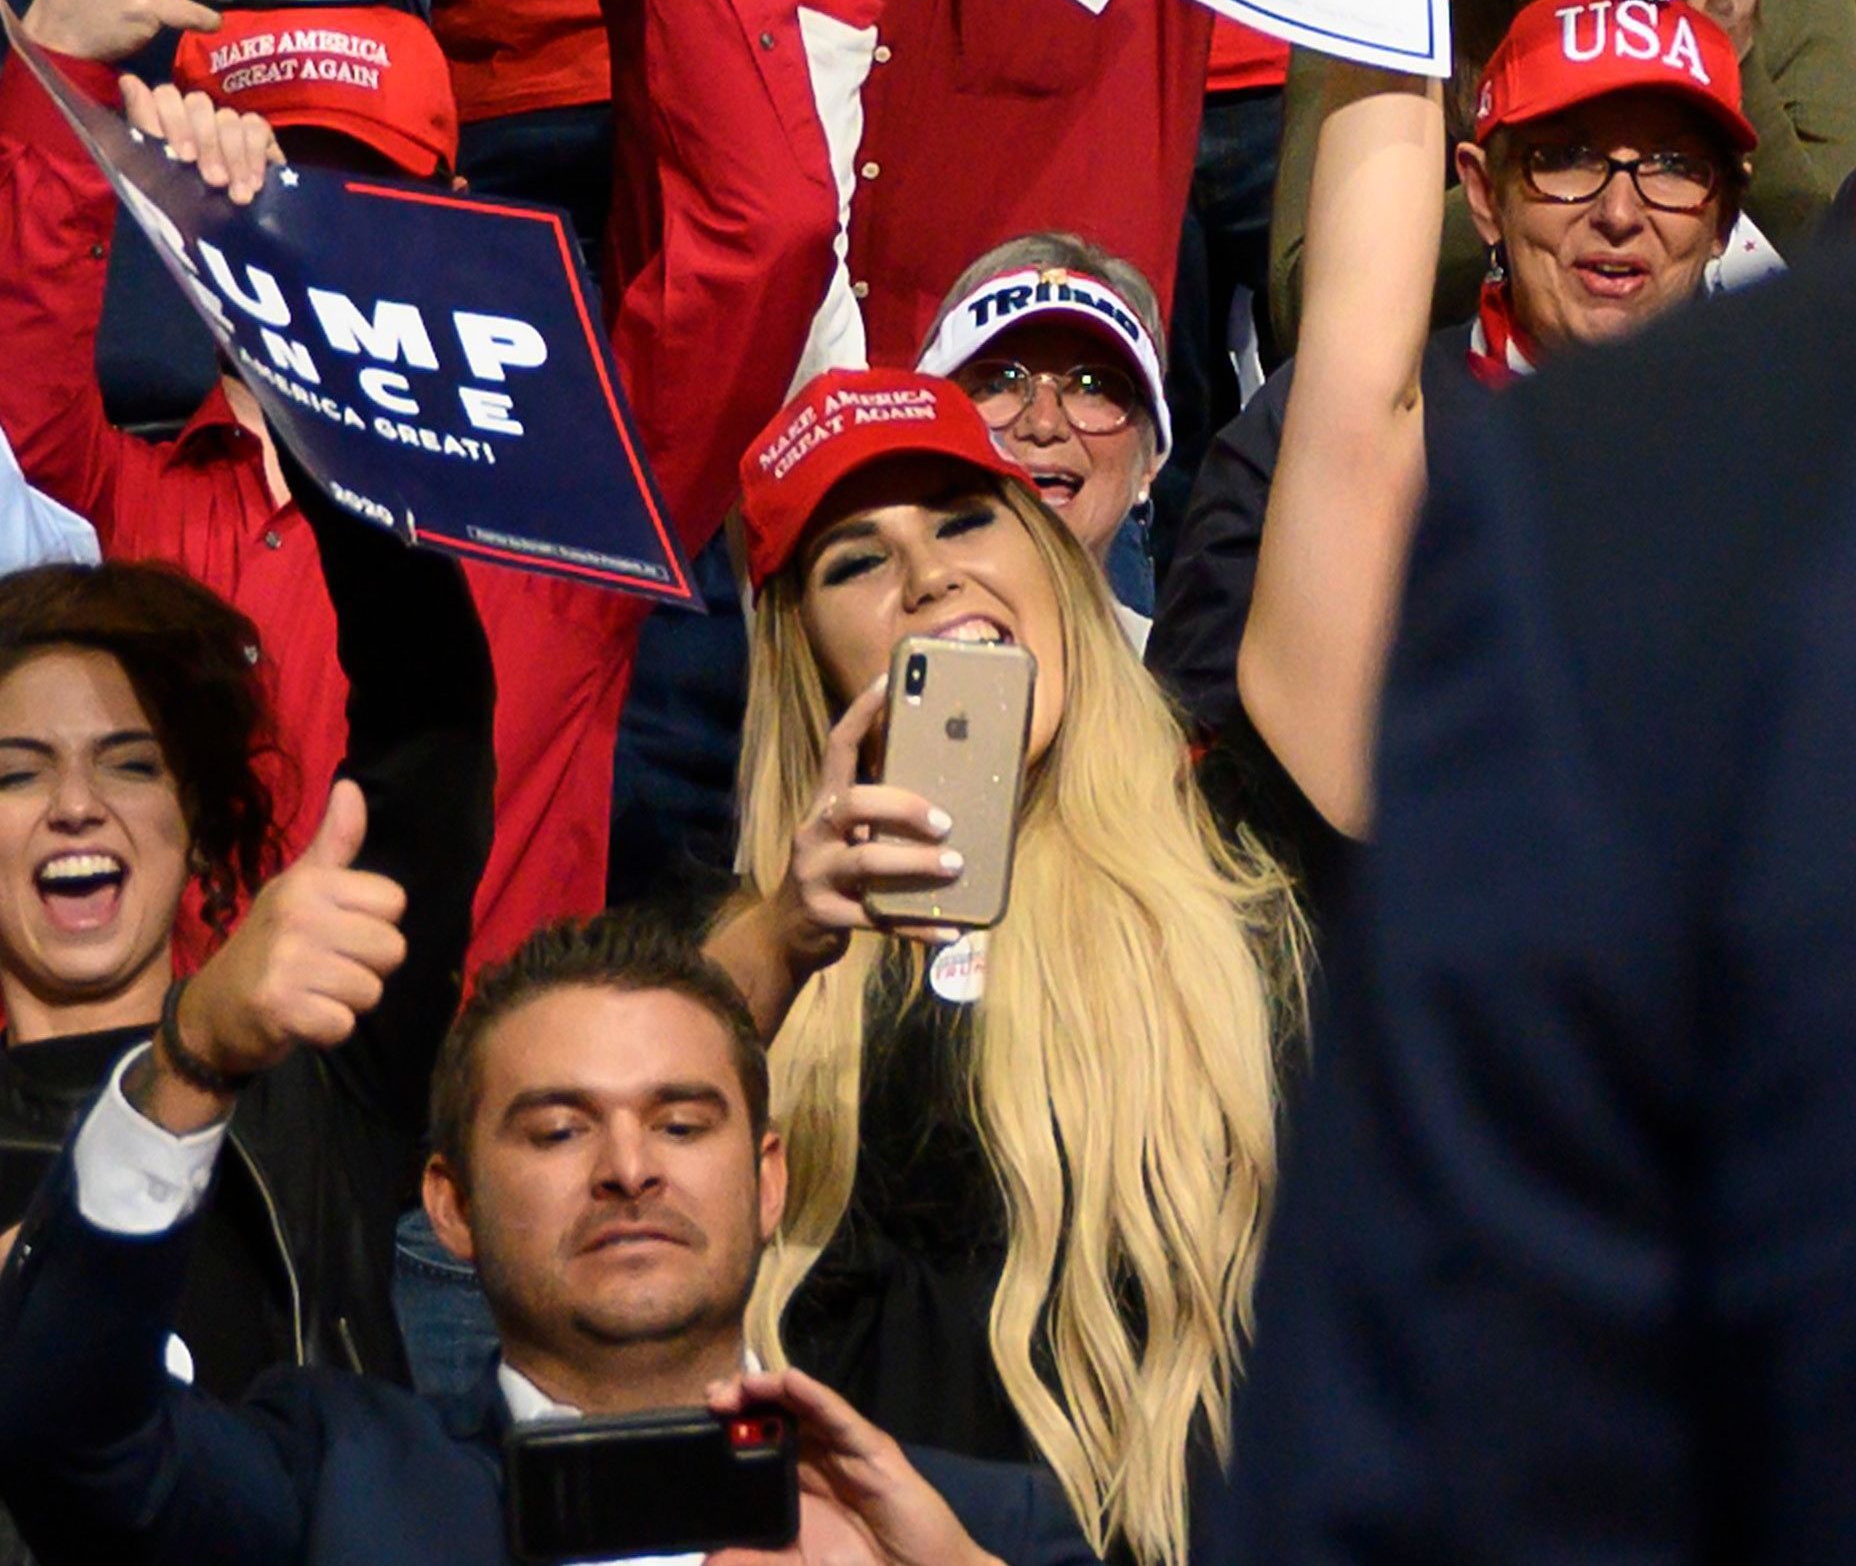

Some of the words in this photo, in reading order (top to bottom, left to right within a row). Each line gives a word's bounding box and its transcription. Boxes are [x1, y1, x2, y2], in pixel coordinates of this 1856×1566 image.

[209, 33, 275, 75] MAKE
[276, 30, 392, 68] AMERICA
[221, 58, 299, 94] GREAT
[300, 58, 380, 90] AGAIN
[160, 219, 548, 382] UMP
[250, 319, 525, 436] NCE
[372, 416, 497, 465] GREAT!
